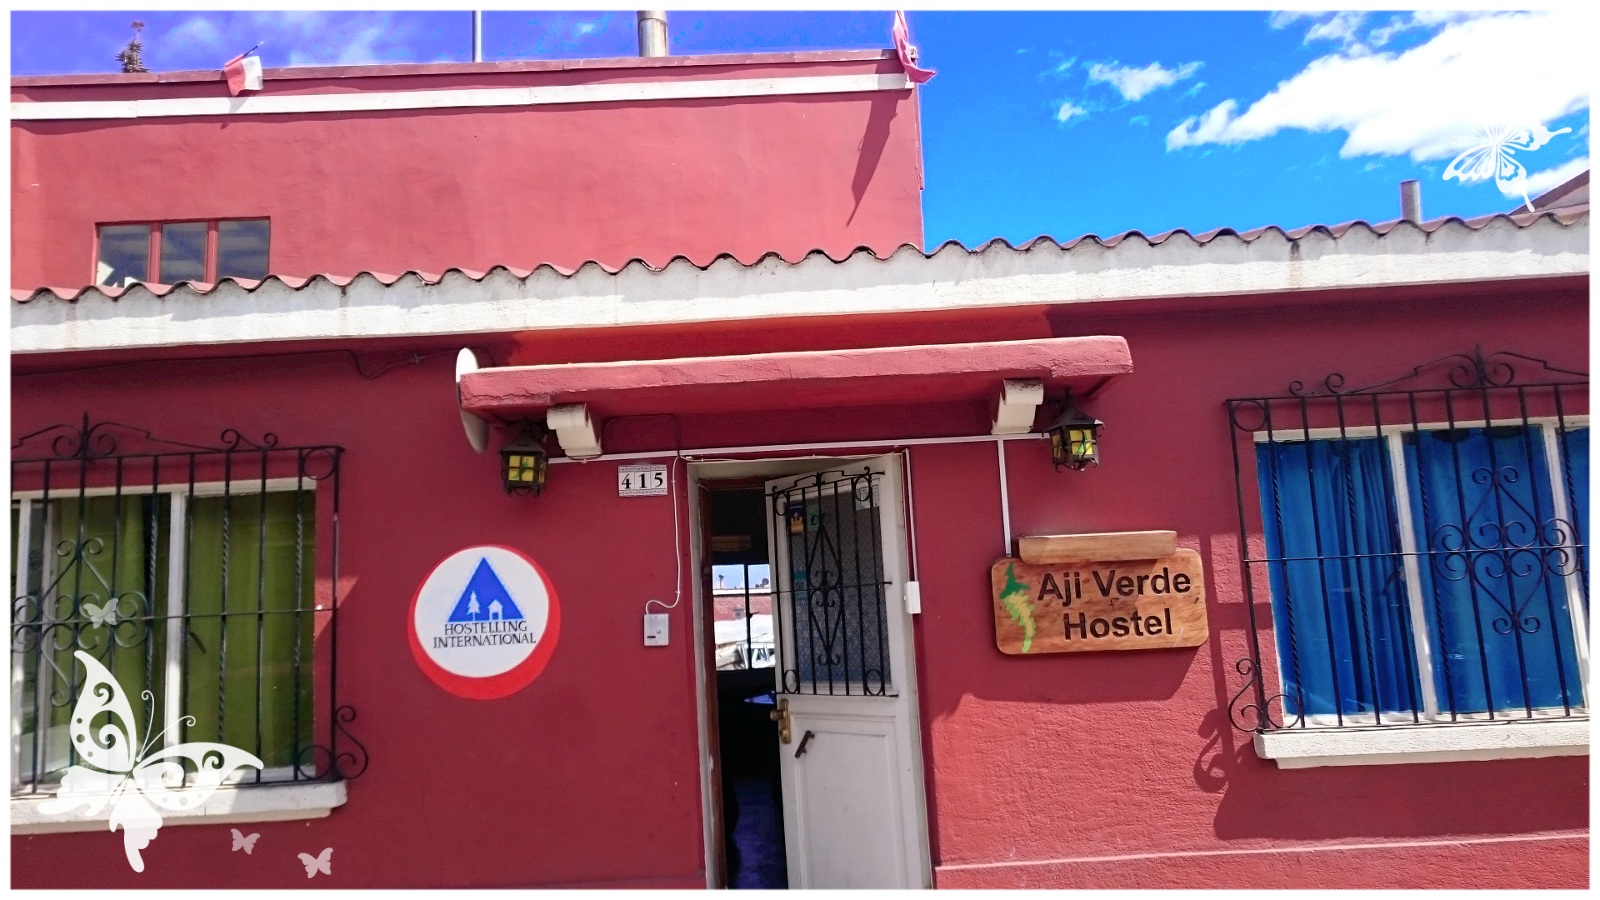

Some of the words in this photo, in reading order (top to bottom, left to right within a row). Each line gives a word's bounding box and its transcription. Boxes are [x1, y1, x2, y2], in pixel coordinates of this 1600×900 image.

[621, 472, 663, 490] 415
[1037, 571, 1082, 607] Aji
[1092, 567, 1191, 597] Verde
[444, 620, 527, 636] HOSTELLING
[1063, 608, 1173, 640] Hostel
[433, 632, 537, 649] INTERNATIONAL
